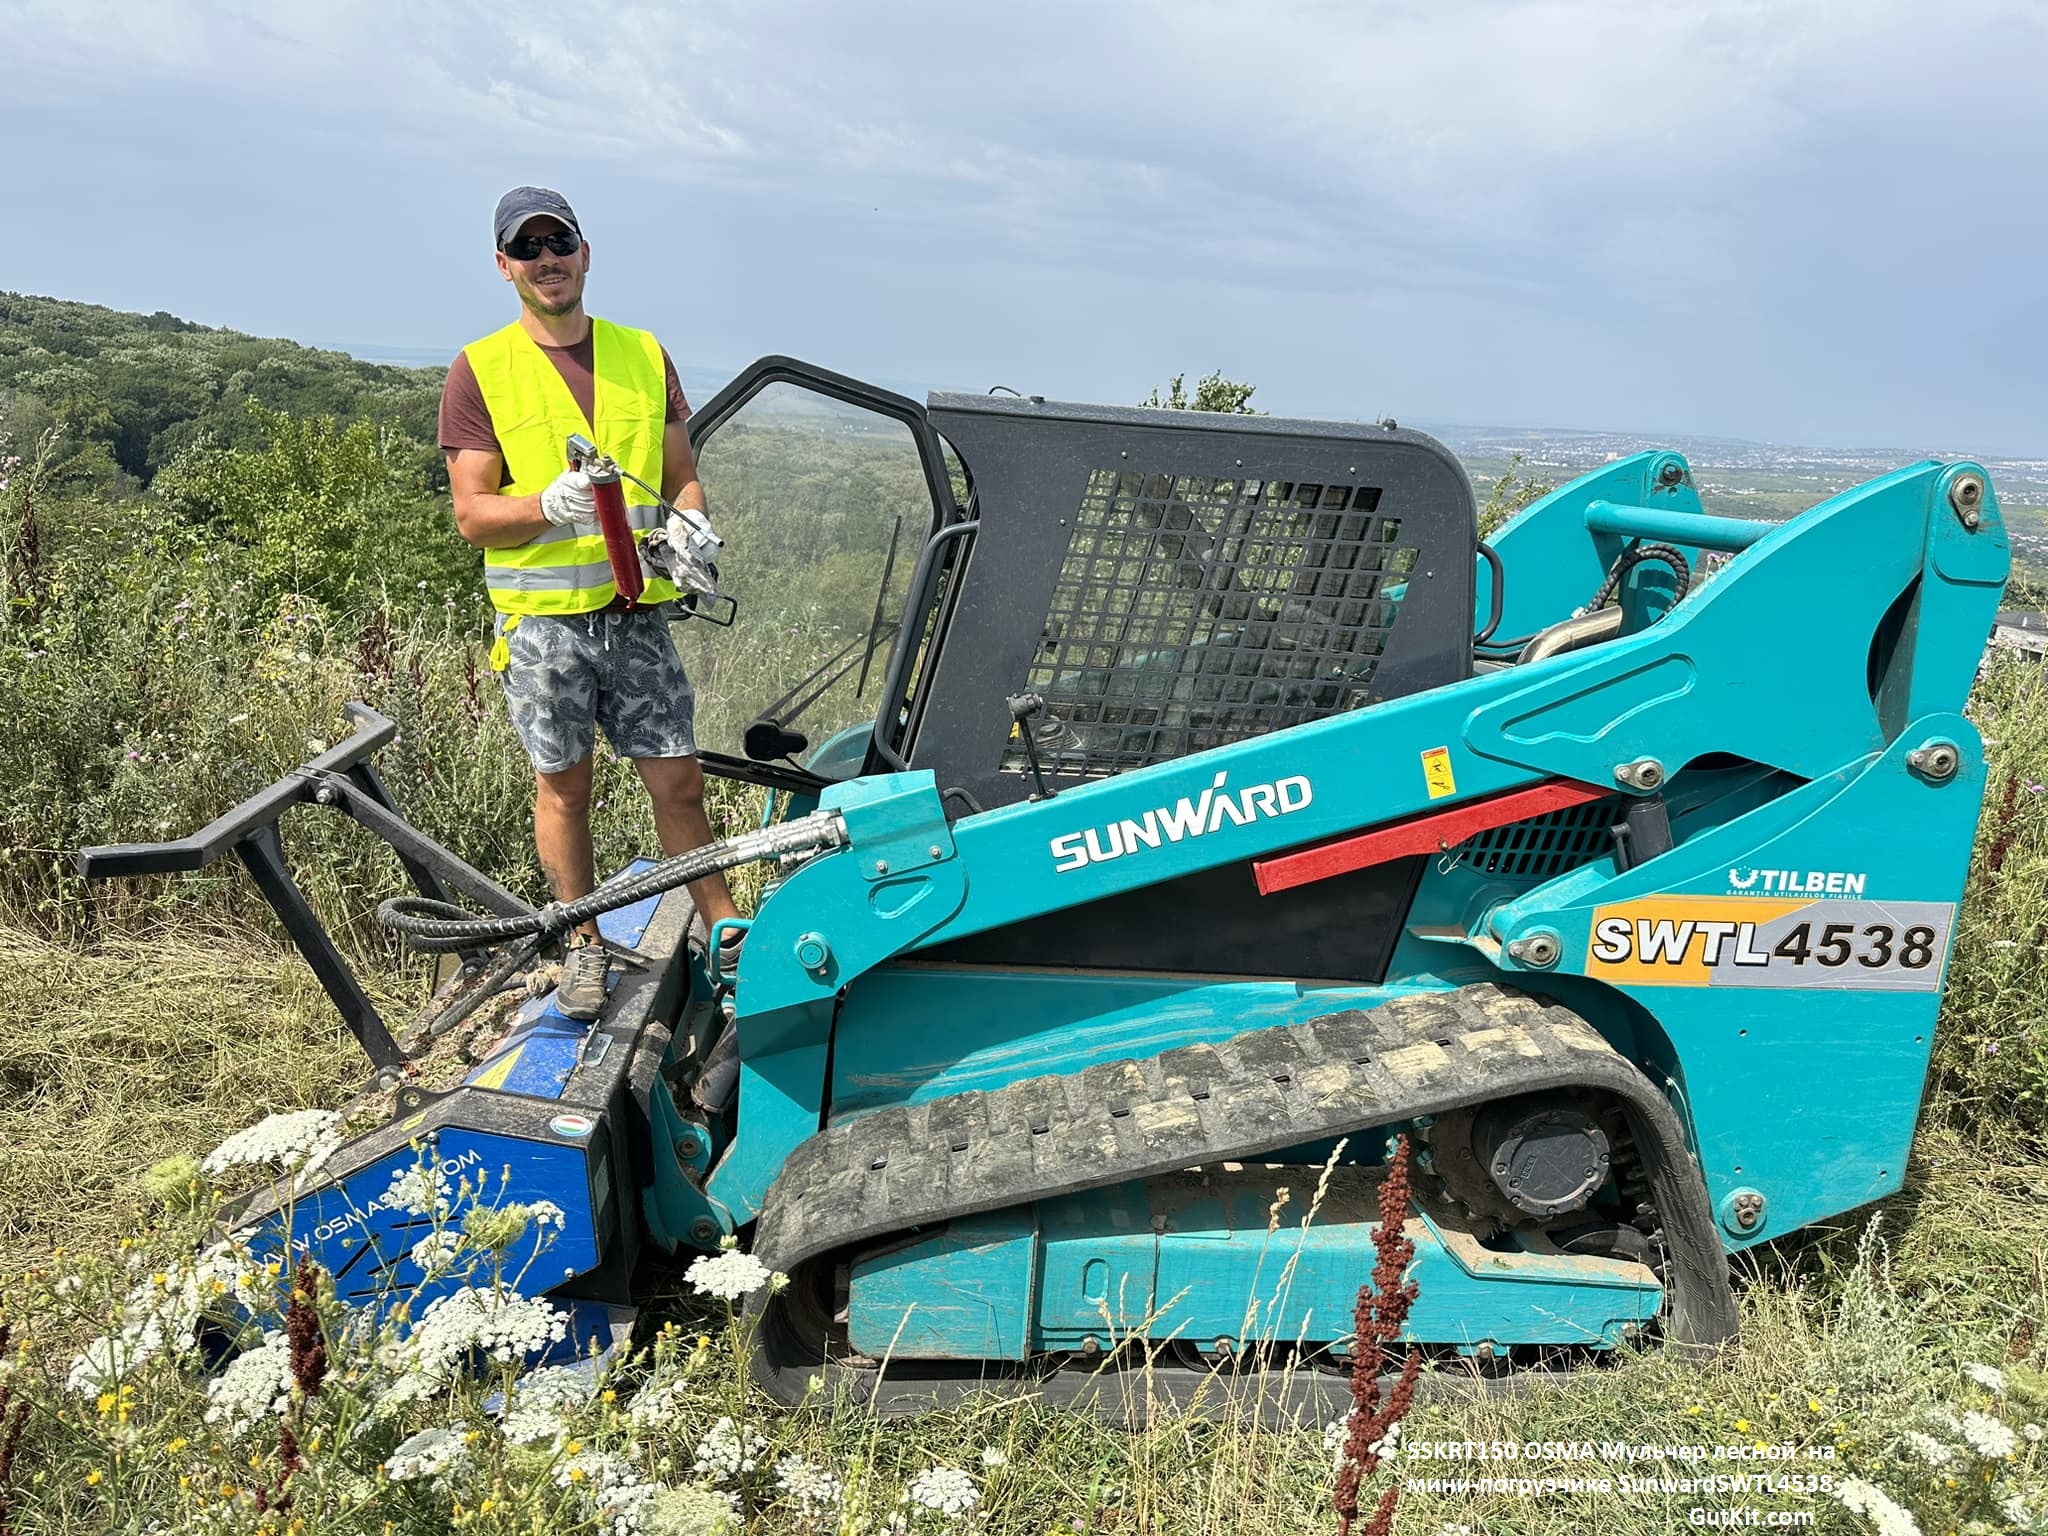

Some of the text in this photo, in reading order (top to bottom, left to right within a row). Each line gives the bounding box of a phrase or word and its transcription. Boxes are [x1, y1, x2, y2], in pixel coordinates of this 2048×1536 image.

[1050, 770, 1313, 873] SUNWARD
[1726, 889, 1770, 897] GARANTIA
[1728, 867, 1866, 893] UTILBEN
[1591, 918, 1938, 970] SWTL4538
